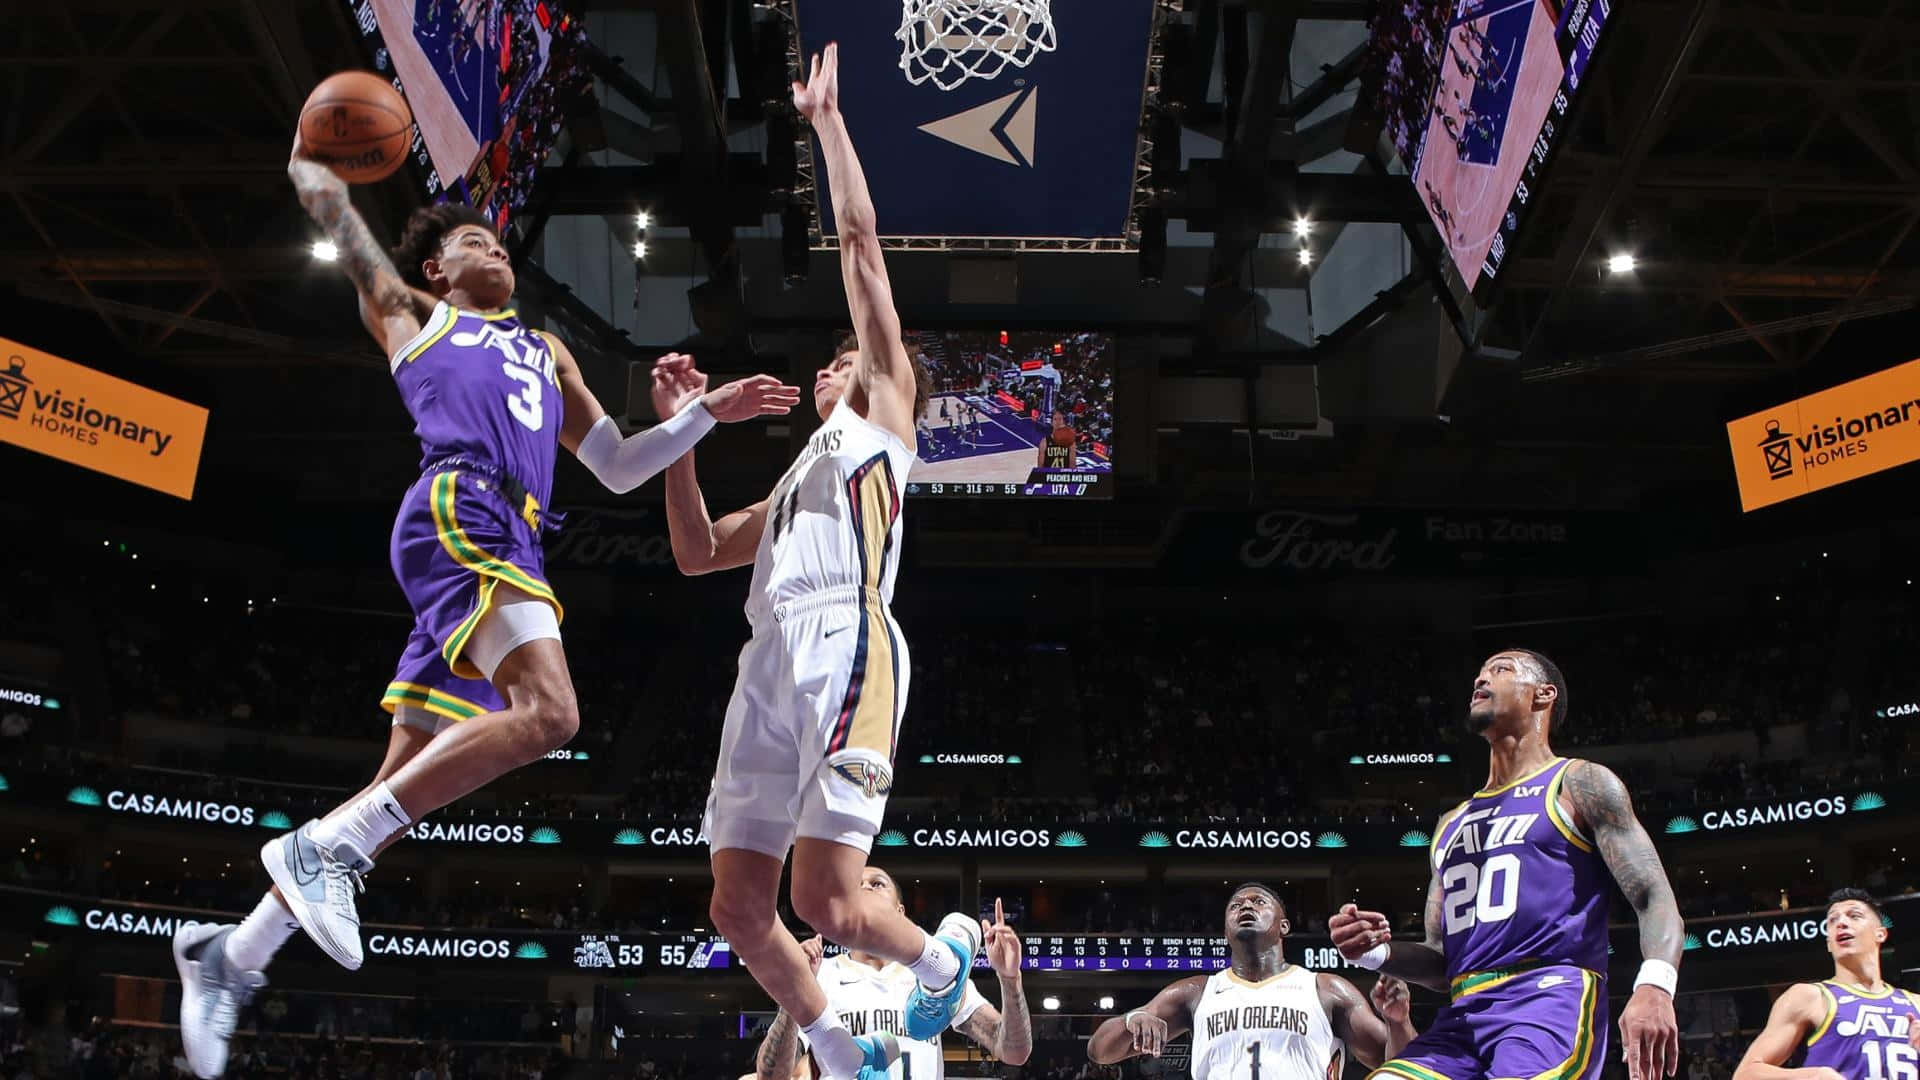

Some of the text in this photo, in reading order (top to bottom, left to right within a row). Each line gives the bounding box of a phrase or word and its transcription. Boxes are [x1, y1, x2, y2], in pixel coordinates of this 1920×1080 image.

[1581, 16, 1600, 50] UTA
[1516, 180, 1529, 204] 53
[1554, 89, 1568, 115] 55
[502, 361, 543, 432] 3
[31, 413, 99, 446] HOMES
[34, 389, 172, 456] visionary
[1047, 447, 1068, 457] UTAH
[1803, 439, 1868, 470] HOMES
[931, 484, 944, 494] 53
[1004, 484, 1017, 494] 55
[1051, 484, 1070, 495] UTA
[1240, 509, 1397, 570] Ford
[1424, 517, 1567, 543] Fan Zone
[1887, 703, 1920, 717] CASA
[936, 753, 1005, 764] CASAMIGOS
[1366, 753, 1434, 764] CASAMIGOS
[106, 790, 255, 826] CASAMIGOS
[1702, 796, 1847, 830] CASAMIGOS
[401, 821, 525, 844] ASAMIGOS
[650, 827, 712, 846] CASA
[913, 829, 1050, 848] CASAMIGOS
[1175, 830, 1312, 848] CASAMIGOS
[1442, 853, 1521, 936] 20
[85, 909, 200, 937] CASAMI
[369, 935, 511, 959] CASAMIGOS
[619, 945, 643, 965] 53
[660, 945, 686, 965] 55
[1028, 946, 1225, 956] 19 24 13 3 1 5 22 112 112
[1304, 948, 1338, 969] 8:06
[1028, 959, 1226, 968] 16 19 14 5 0 4 22 112 112
[1207, 1006, 1309, 1040] NEW ORLEANS
[1246, 1041, 1261, 1080] 1
[1861, 1040, 1919, 1080] 16
